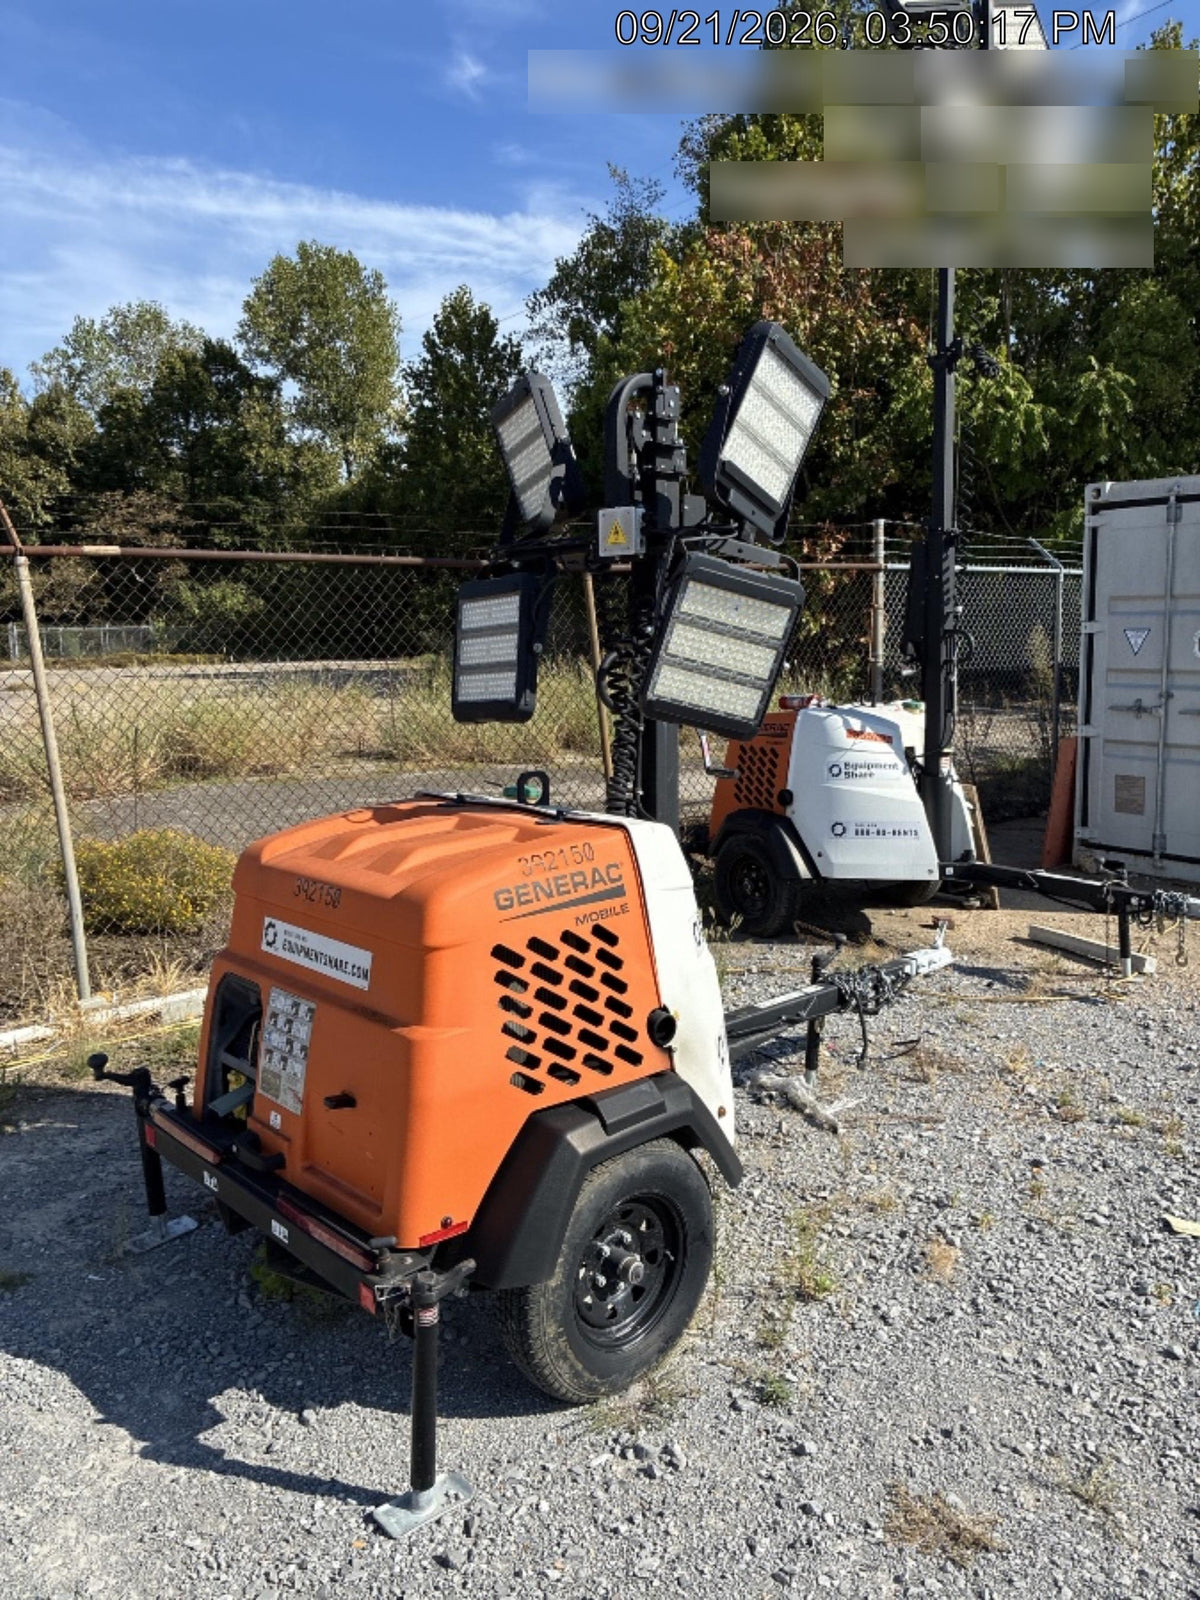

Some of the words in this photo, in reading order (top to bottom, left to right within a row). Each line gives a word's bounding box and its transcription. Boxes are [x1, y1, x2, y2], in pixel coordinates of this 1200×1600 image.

[844, 771, 875, 780] Share
[518, 842, 595, 877] 392150
[292, 878, 342, 909] 392150
[494, 863, 623, 911] GENERAC
[575, 903, 631, 926] MOBILE
